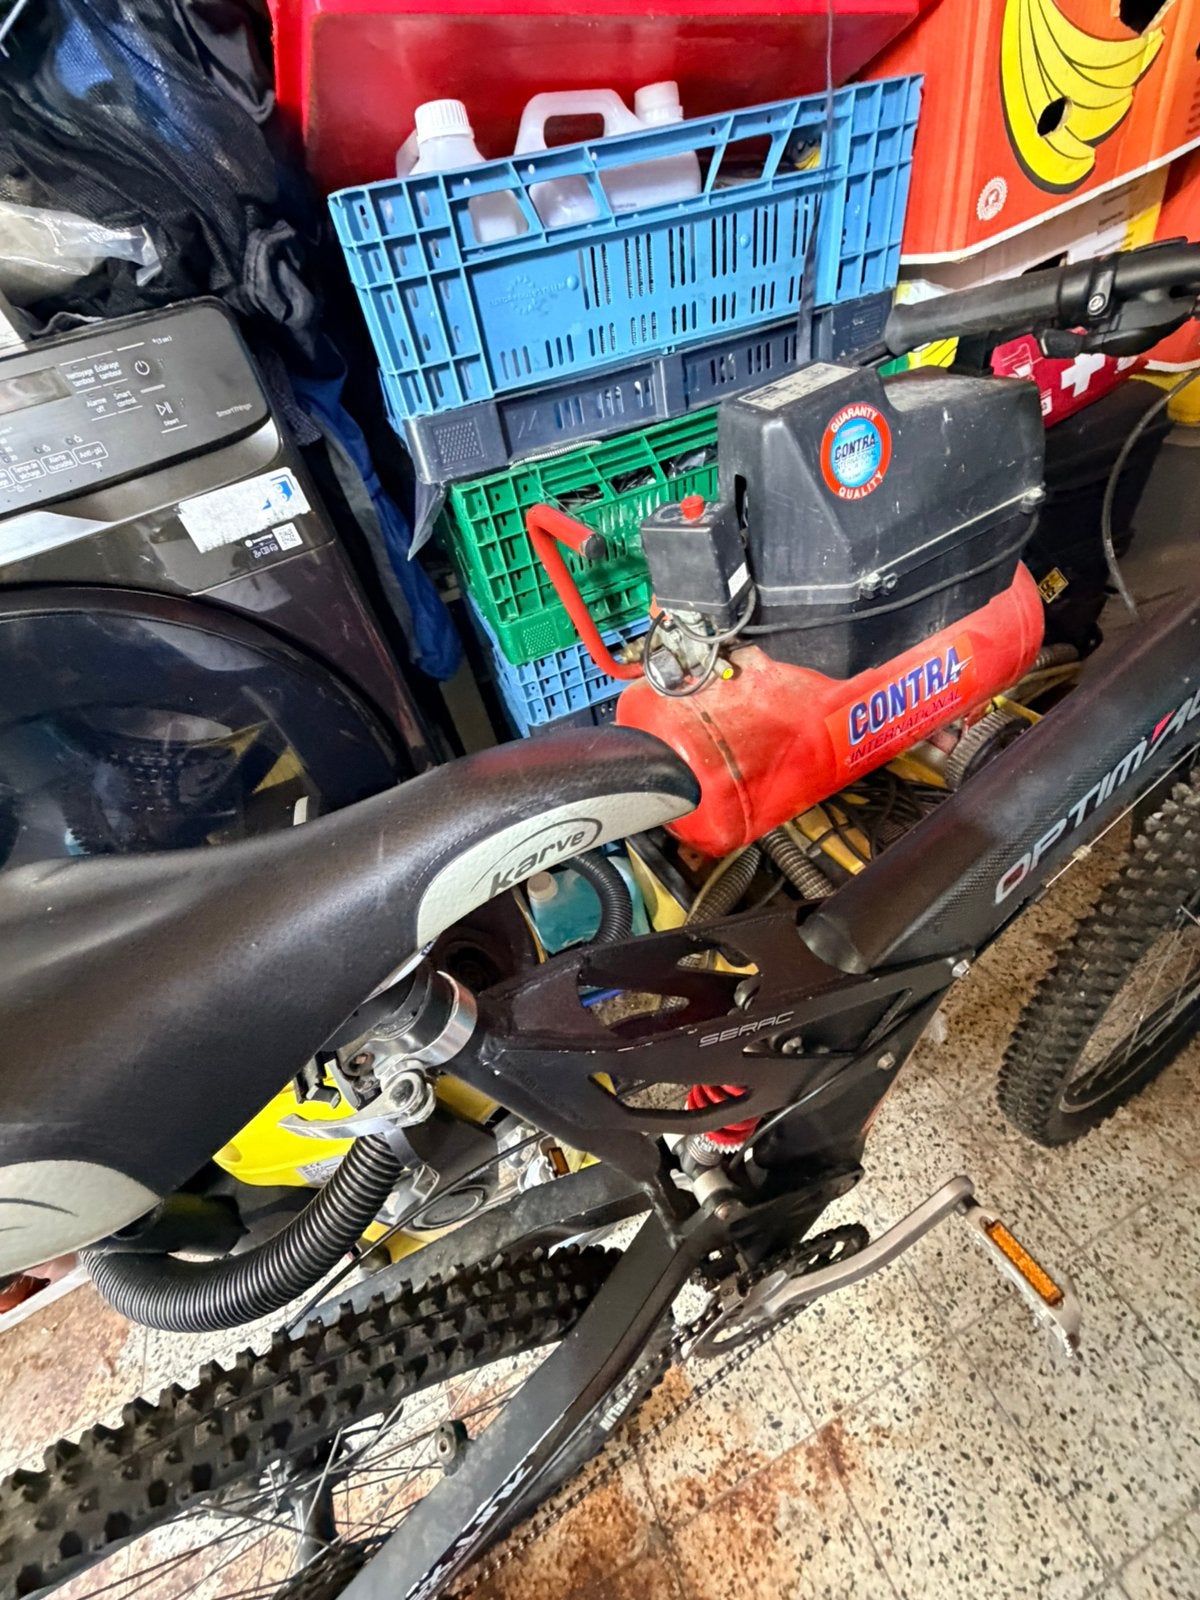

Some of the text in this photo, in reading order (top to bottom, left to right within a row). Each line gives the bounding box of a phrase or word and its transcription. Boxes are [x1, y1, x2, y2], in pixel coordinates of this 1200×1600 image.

[830, 405, 878, 433] GUARANTY
[834, 431, 876, 461] CONTRA
[838, 470, 883, 500] QUALITY
[848, 645, 963, 746] CONTRA
[849, 688, 961, 765] INTERNATIONAL
[488, 830, 586, 900] karve
[698, 1010, 795, 1048] SERAC
